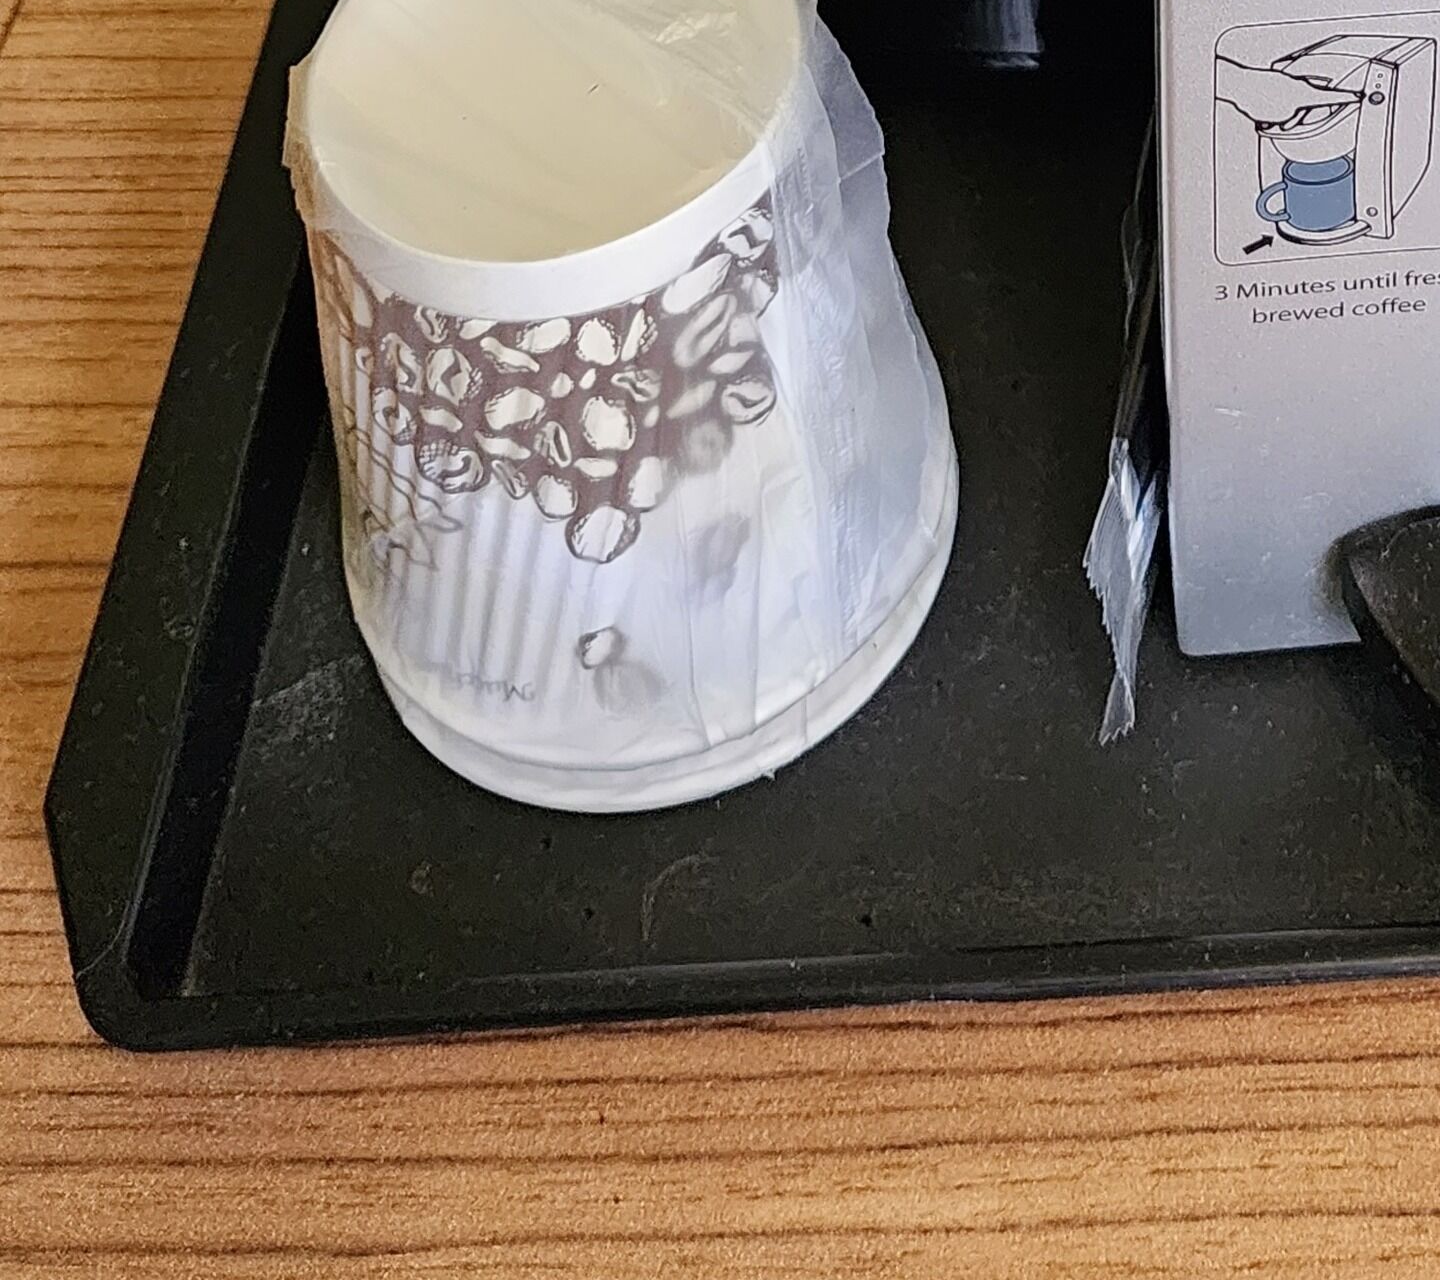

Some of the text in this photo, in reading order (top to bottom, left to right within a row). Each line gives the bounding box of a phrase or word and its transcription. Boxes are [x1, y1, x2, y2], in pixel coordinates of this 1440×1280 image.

[1214, 284, 1228, 300] 3
[1236, 280, 1336, 300] Minutes
[1343, 271, 1397, 292] until
[1252, 297, 1427, 324] brewed coffee
